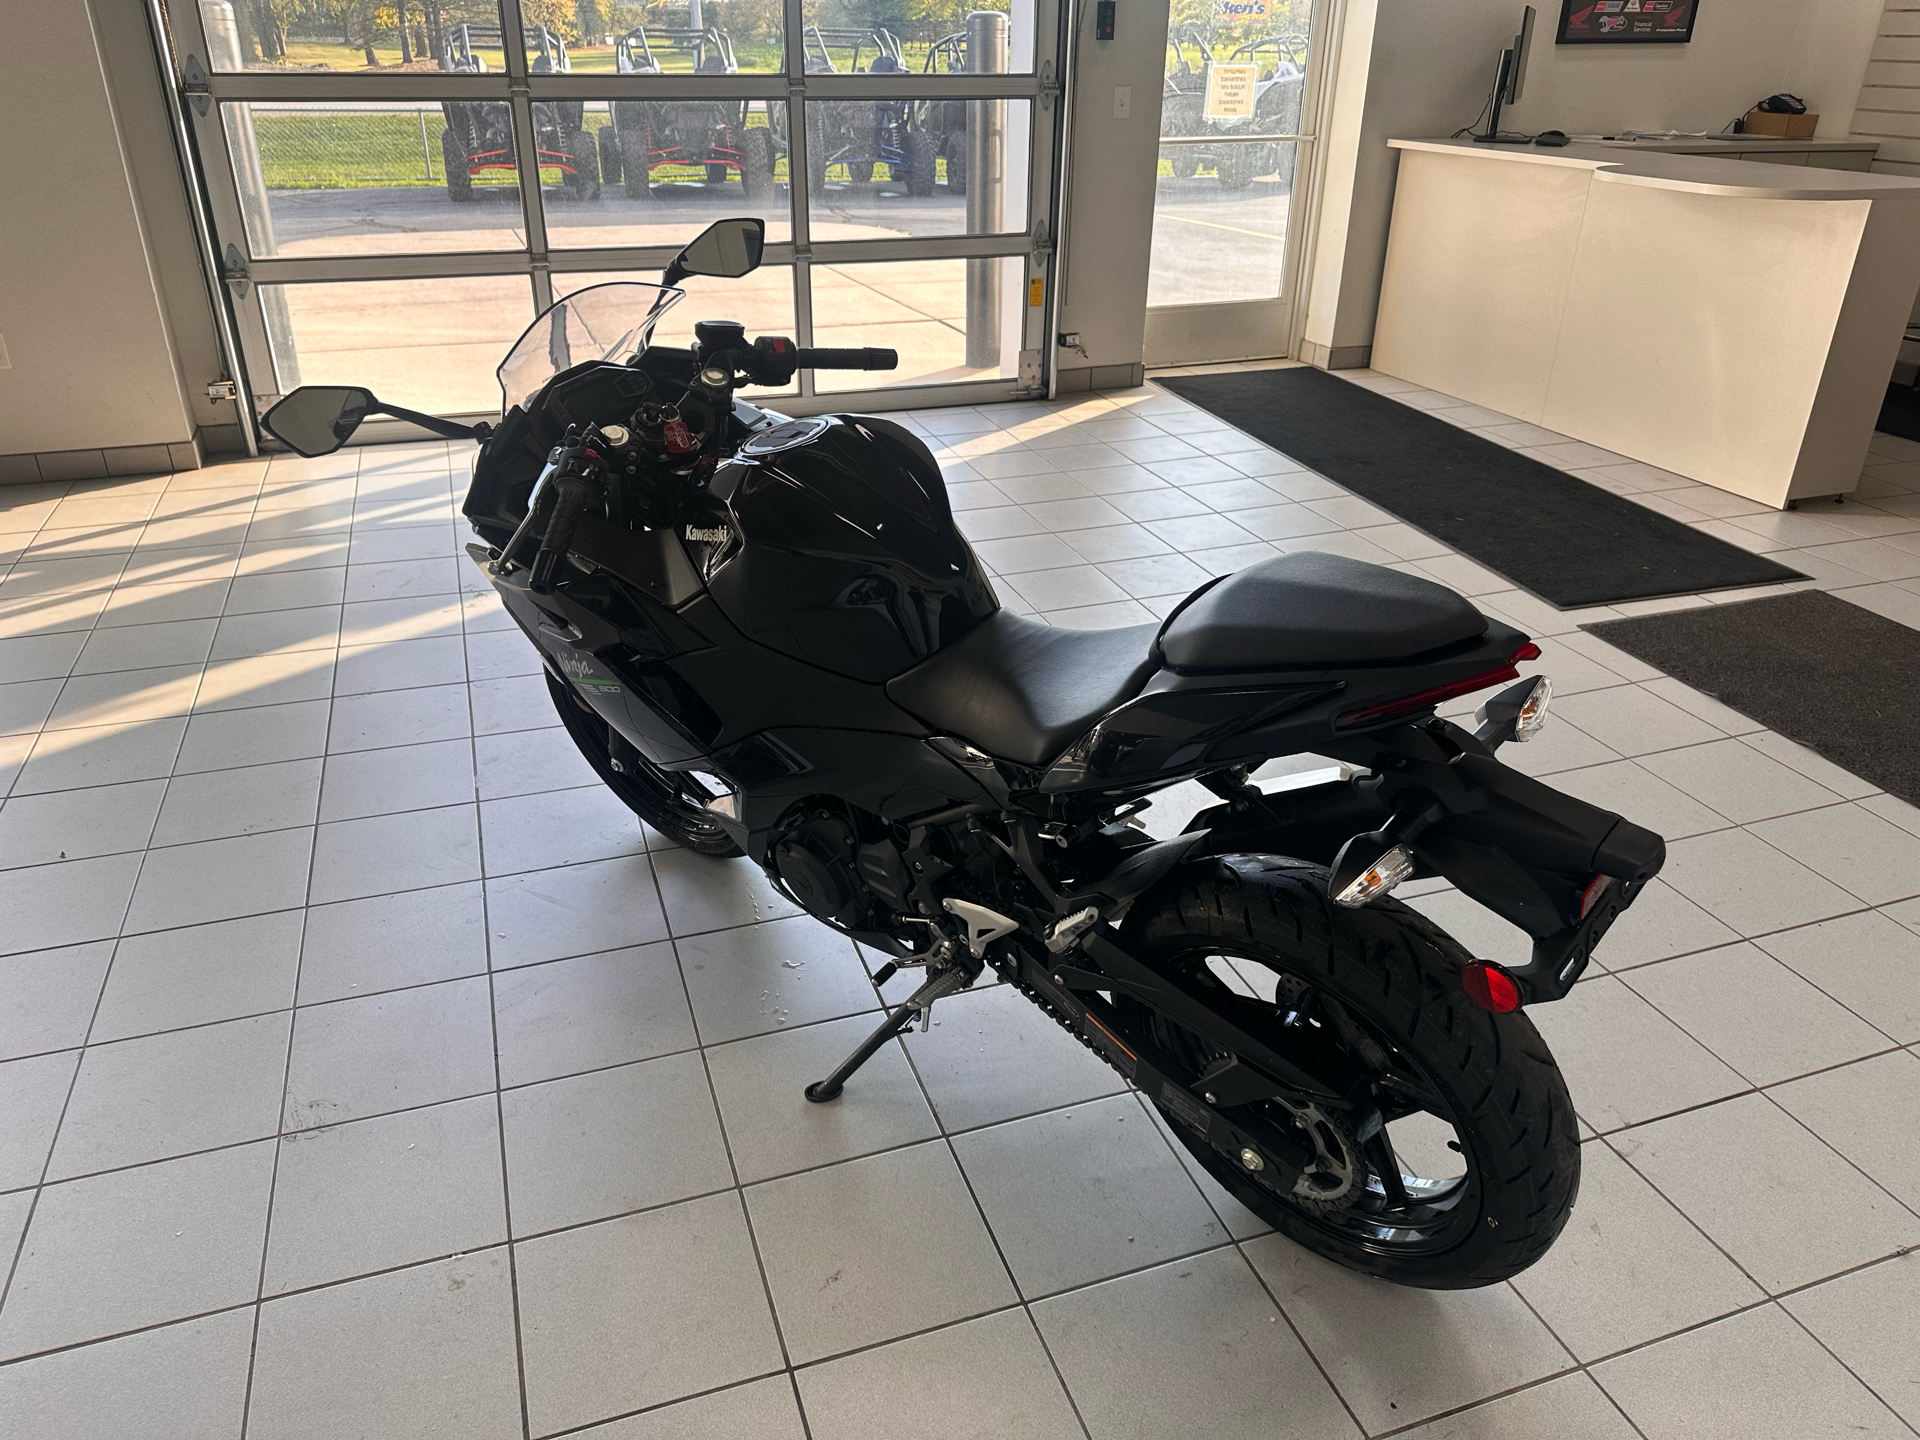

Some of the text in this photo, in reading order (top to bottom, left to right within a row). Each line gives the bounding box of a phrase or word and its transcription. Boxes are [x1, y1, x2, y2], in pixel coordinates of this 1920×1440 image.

[1222, 0, 1265, 14] ken's
[685, 524, 727, 541] Kawasaki
[556, 651, 594, 679] Ninja
[598, 685, 621, 693] 500
